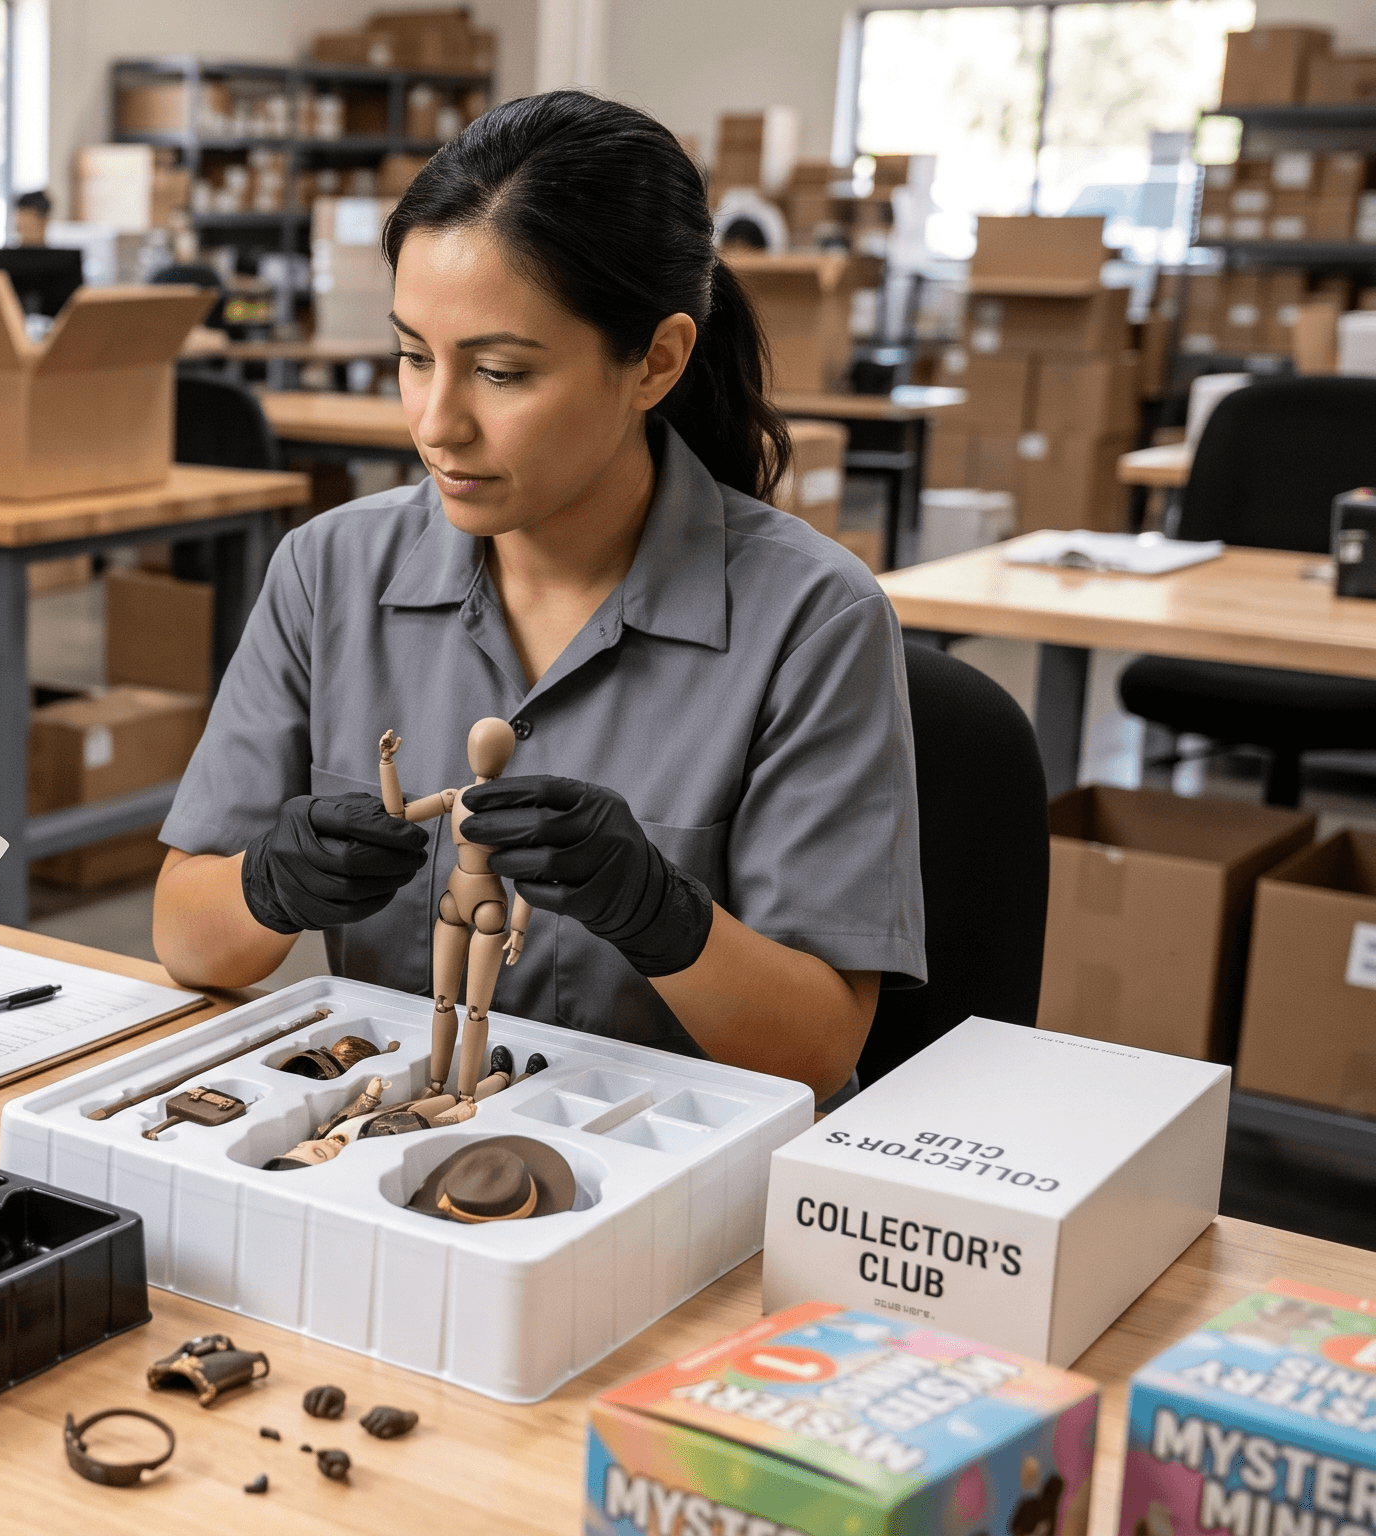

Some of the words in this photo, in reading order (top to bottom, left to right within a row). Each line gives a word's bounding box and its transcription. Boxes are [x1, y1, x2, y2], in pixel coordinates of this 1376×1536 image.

[825, 1131, 1060, 1192] COLLECTOR'S
[914, 1131, 1005, 1159] CLUB
[796, 1196, 1022, 1276] COLLECTOR'S
[859, 1251, 944, 1298] CLUB
[1153, 1407, 1376, 1526] MYSTER
